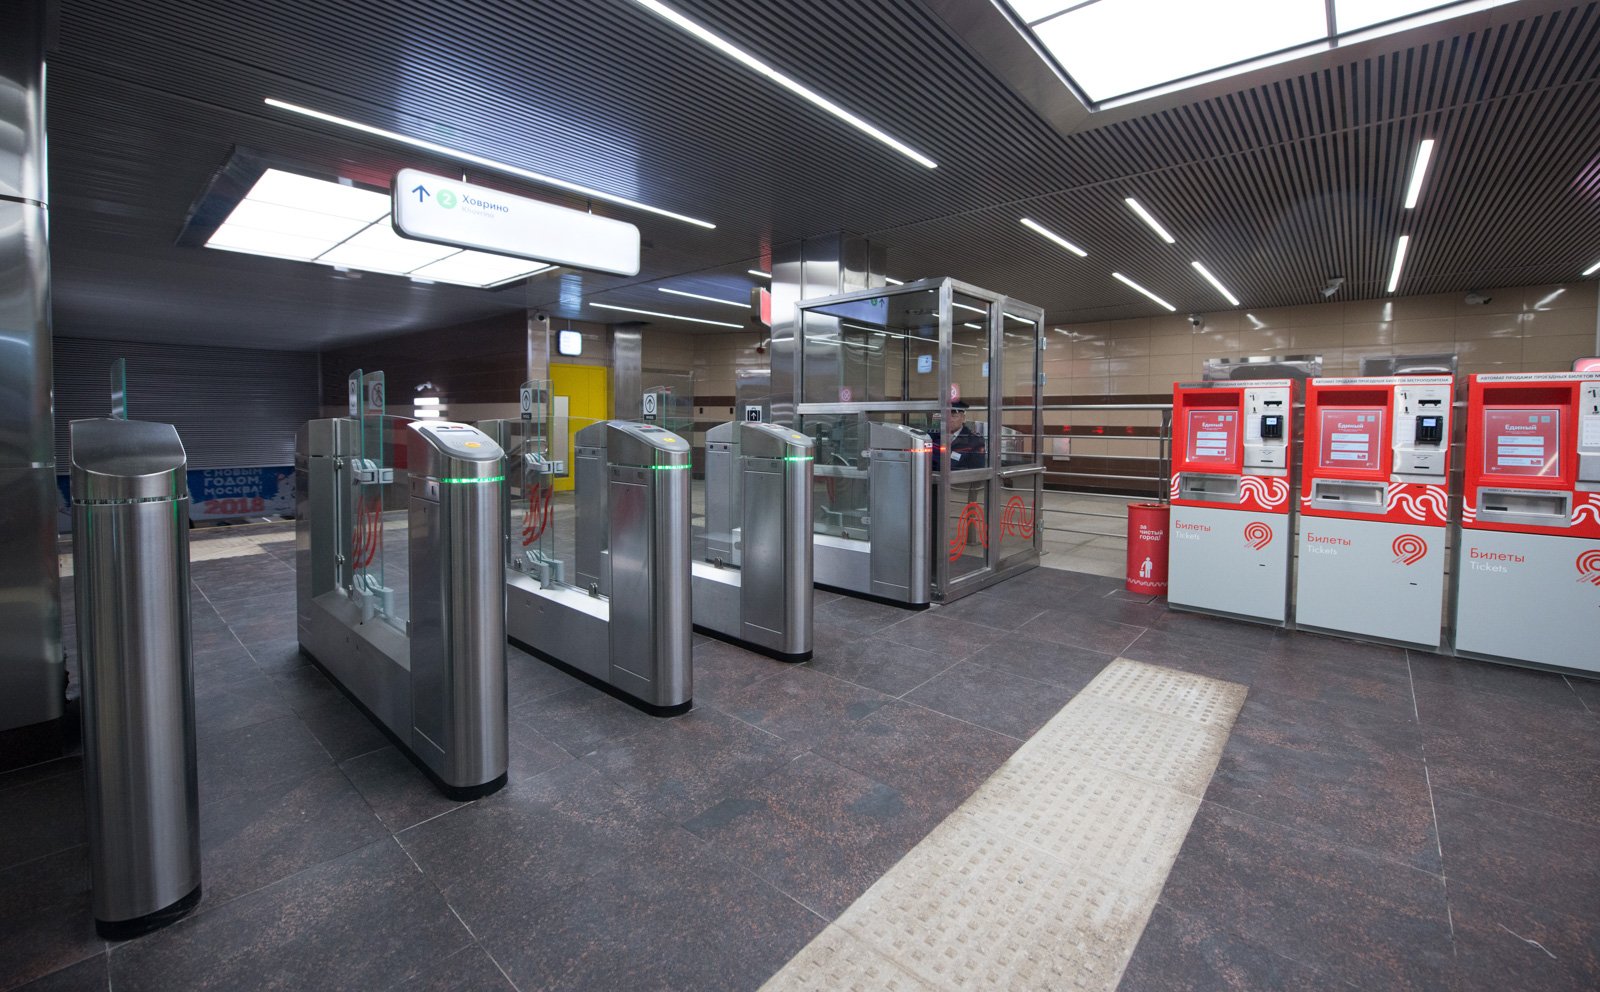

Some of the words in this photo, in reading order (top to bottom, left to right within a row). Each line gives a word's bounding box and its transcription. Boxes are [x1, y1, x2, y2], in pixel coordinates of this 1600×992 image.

[463, 194, 509, 213] Ховрино
[204, 476, 263, 487] ГОДОМ,
[204, 486, 263, 496] МОСКВА!
[204, 497, 264, 514] 2018
[1175, 520, 1212, 532] Билеты
[1175, 530, 1200, 540] Tickets
[1307, 532, 1351, 546] Билеты
[1307, 544, 1337, 555] Tickets
[1470, 548, 1525, 562] Билеты
[1471, 561, 1508, 573] Tickets
